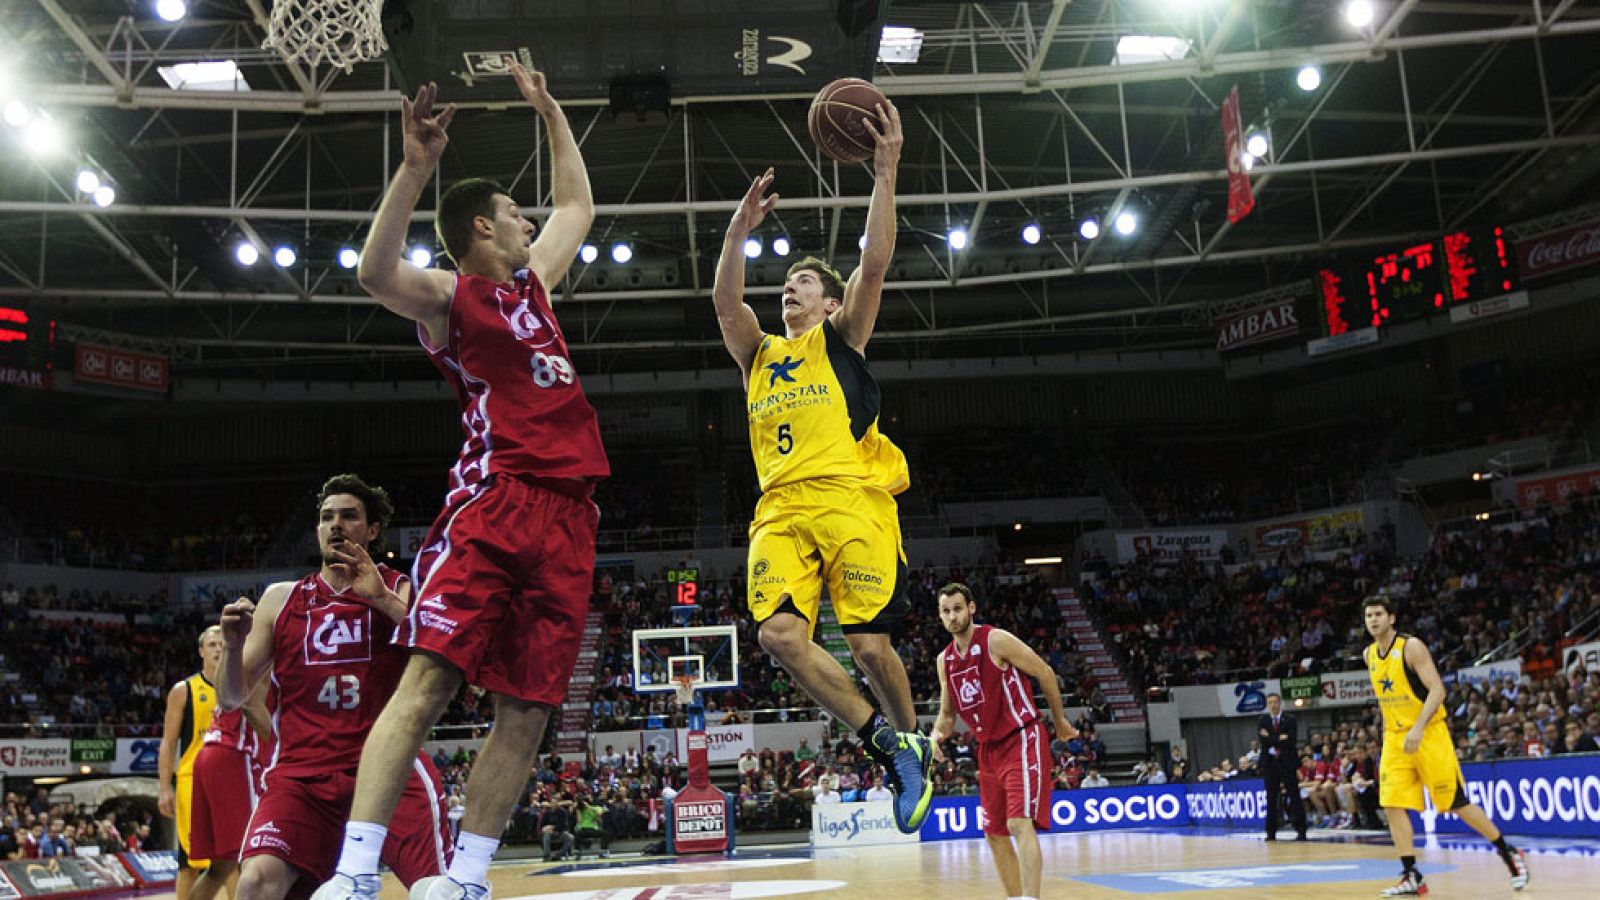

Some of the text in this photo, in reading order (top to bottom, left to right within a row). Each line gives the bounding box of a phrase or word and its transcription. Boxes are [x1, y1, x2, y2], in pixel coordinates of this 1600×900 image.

[1217, 304, 1297, 347] AMBAR
[0, 368, 43, 384] BAR
[530, 351, 573, 388] 89
[777, 423, 793, 455] 5
[841, 569, 882, 585] Volcano
[677, 582, 698, 604] 12
[318, 674, 361, 710] 43
[21, 745, 67, 758] Zaragoza
[678, 804, 721, 817] BRICO
[1084, 793, 1180, 824] SOCIO
[1465, 775, 1600, 822] EVO SOCIO
[934, 806, 967, 833] TU
